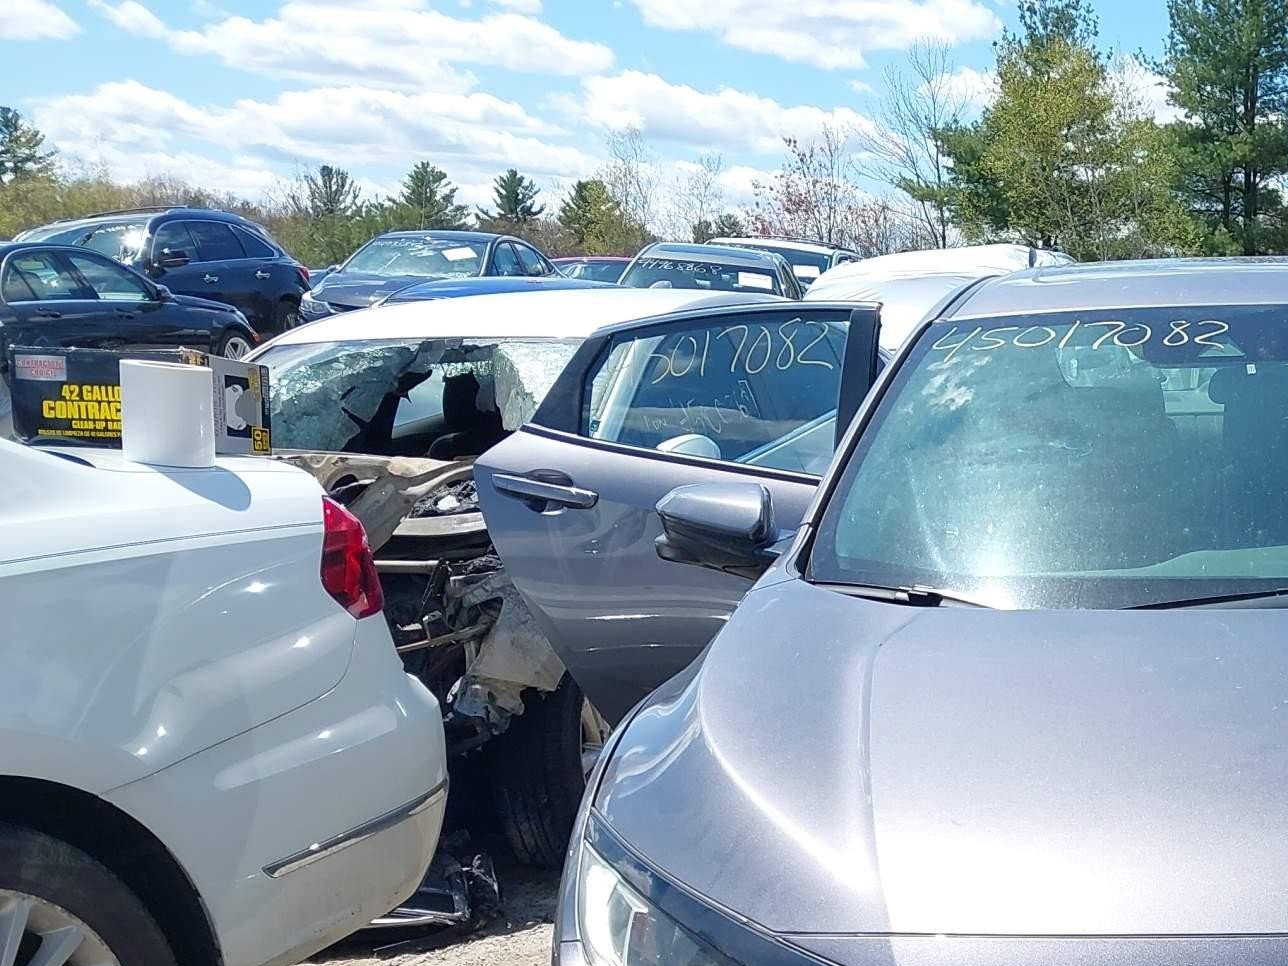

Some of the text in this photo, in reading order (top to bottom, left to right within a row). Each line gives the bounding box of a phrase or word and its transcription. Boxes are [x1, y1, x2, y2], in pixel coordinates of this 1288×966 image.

[930, 319, 1231, 363] 45017082
[61, 384, 80, 400] 42
[42, 400, 121, 419] CONTRAC
